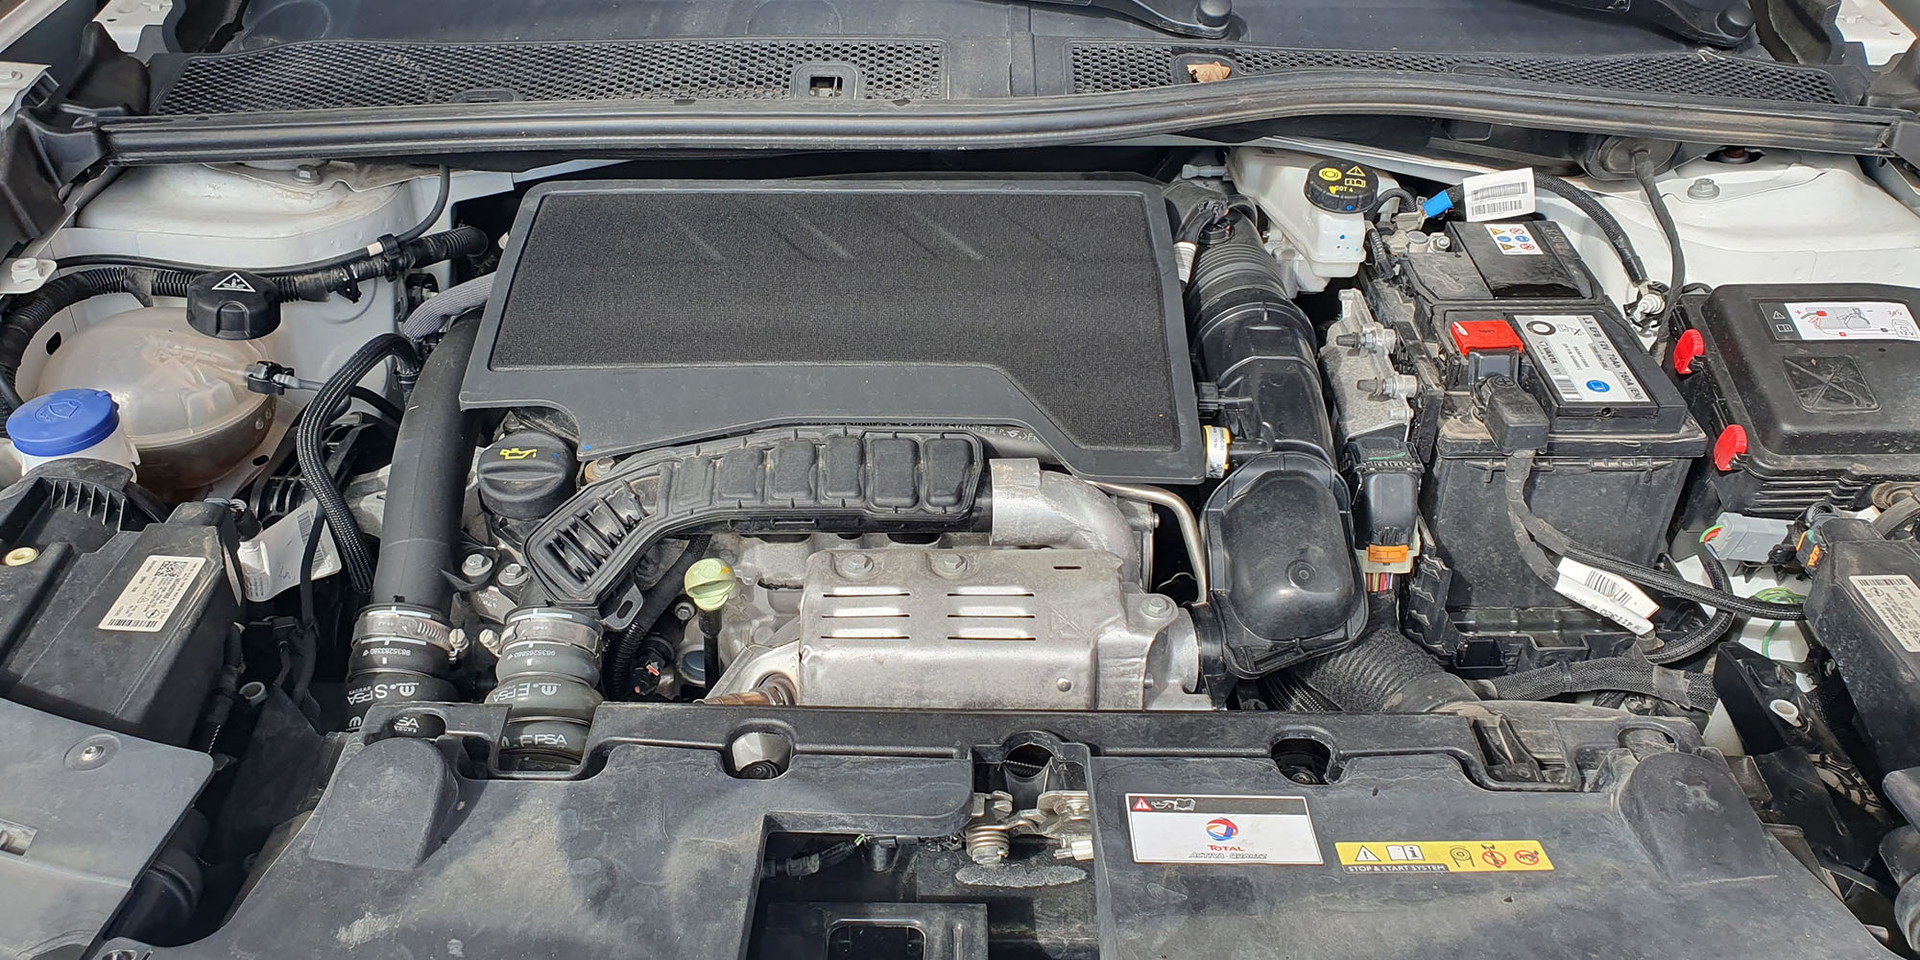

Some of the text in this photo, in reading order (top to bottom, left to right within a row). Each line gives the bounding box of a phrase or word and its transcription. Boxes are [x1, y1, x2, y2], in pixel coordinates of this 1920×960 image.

[1598, 340, 1611, 352] 12V
[347, 690, 374, 705] PSA
[492, 688, 517, 702] PSA
[534, 734, 568, 746] PSA
